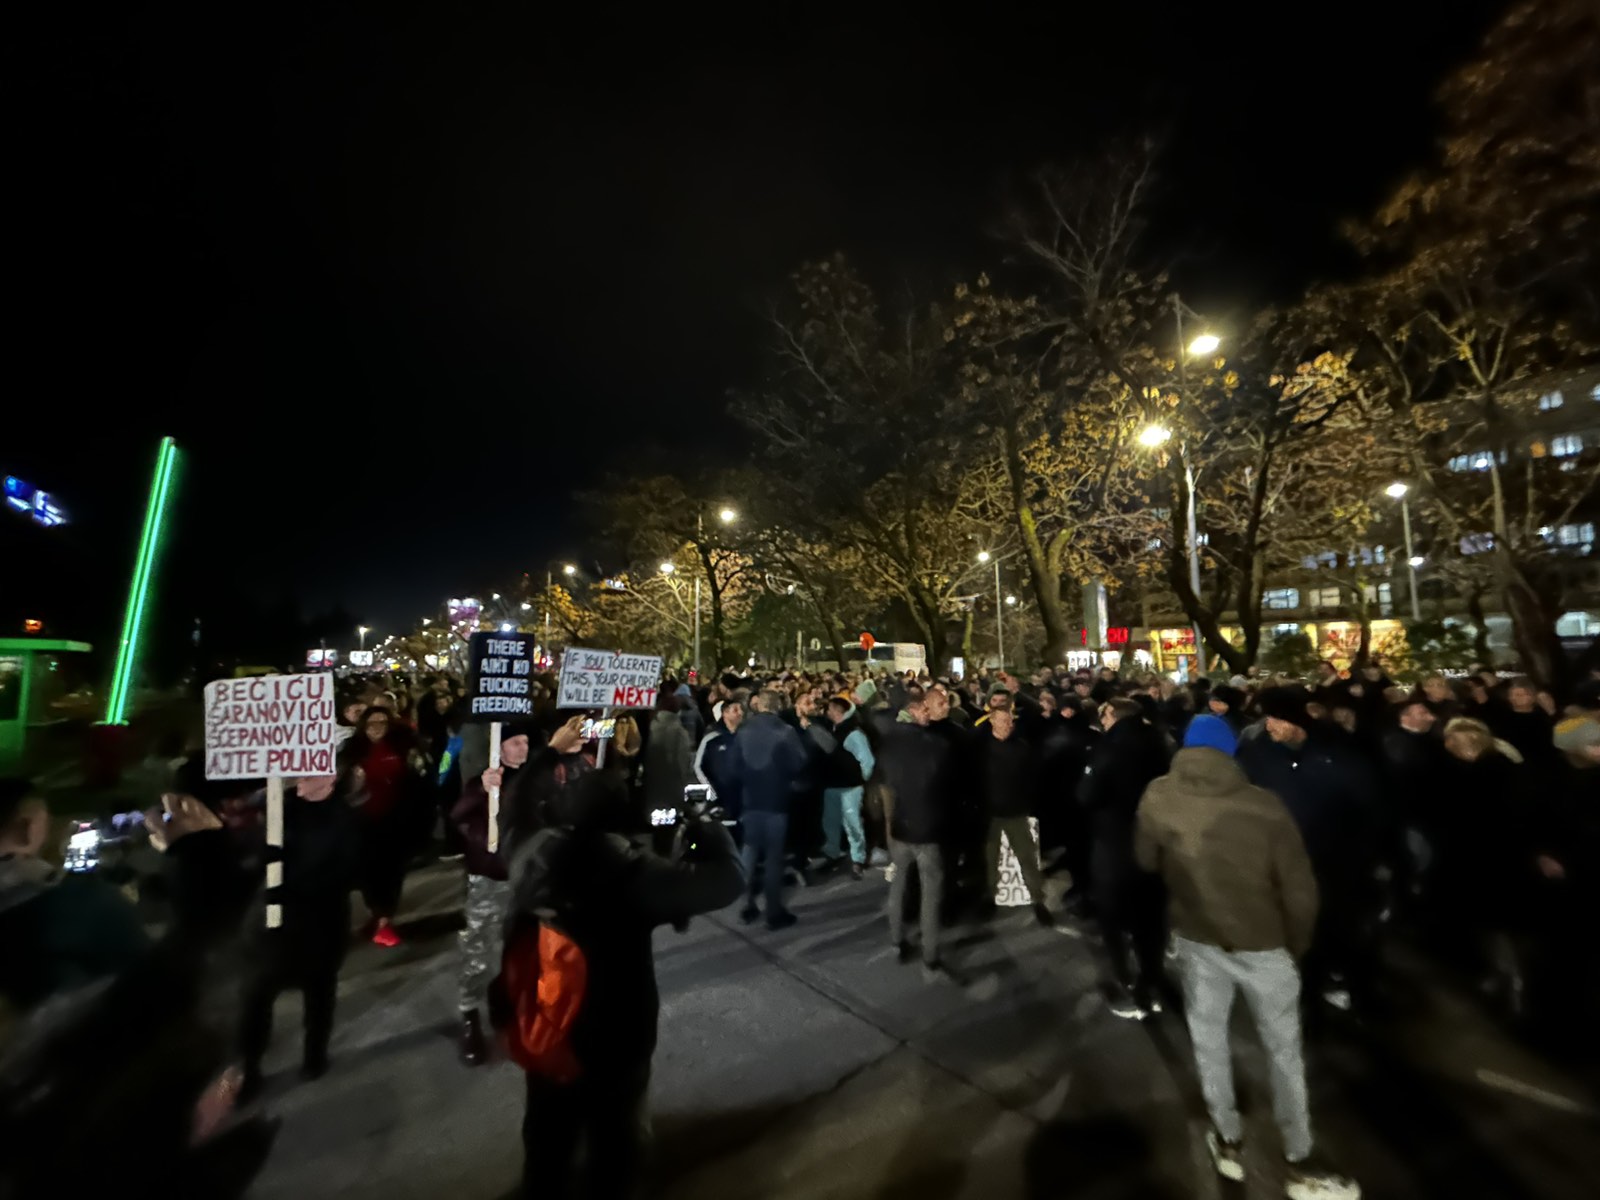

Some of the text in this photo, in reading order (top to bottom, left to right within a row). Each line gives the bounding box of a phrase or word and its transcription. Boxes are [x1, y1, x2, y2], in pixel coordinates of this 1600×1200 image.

[486, 639, 526, 656] THERE
[512, 659, 530, 675] NO
[567, 651, 659, 673] IF YOU TOLERATE
[480, 677, 530, 694] FUCKING
[594, 672, 619, 687] YOUR
[565, 686, 657, 706] WILL BE NEXT
[472, 696, 533, 714] FREEDOM!
[207, 743, 334, 775] AJTE POLAKO!
